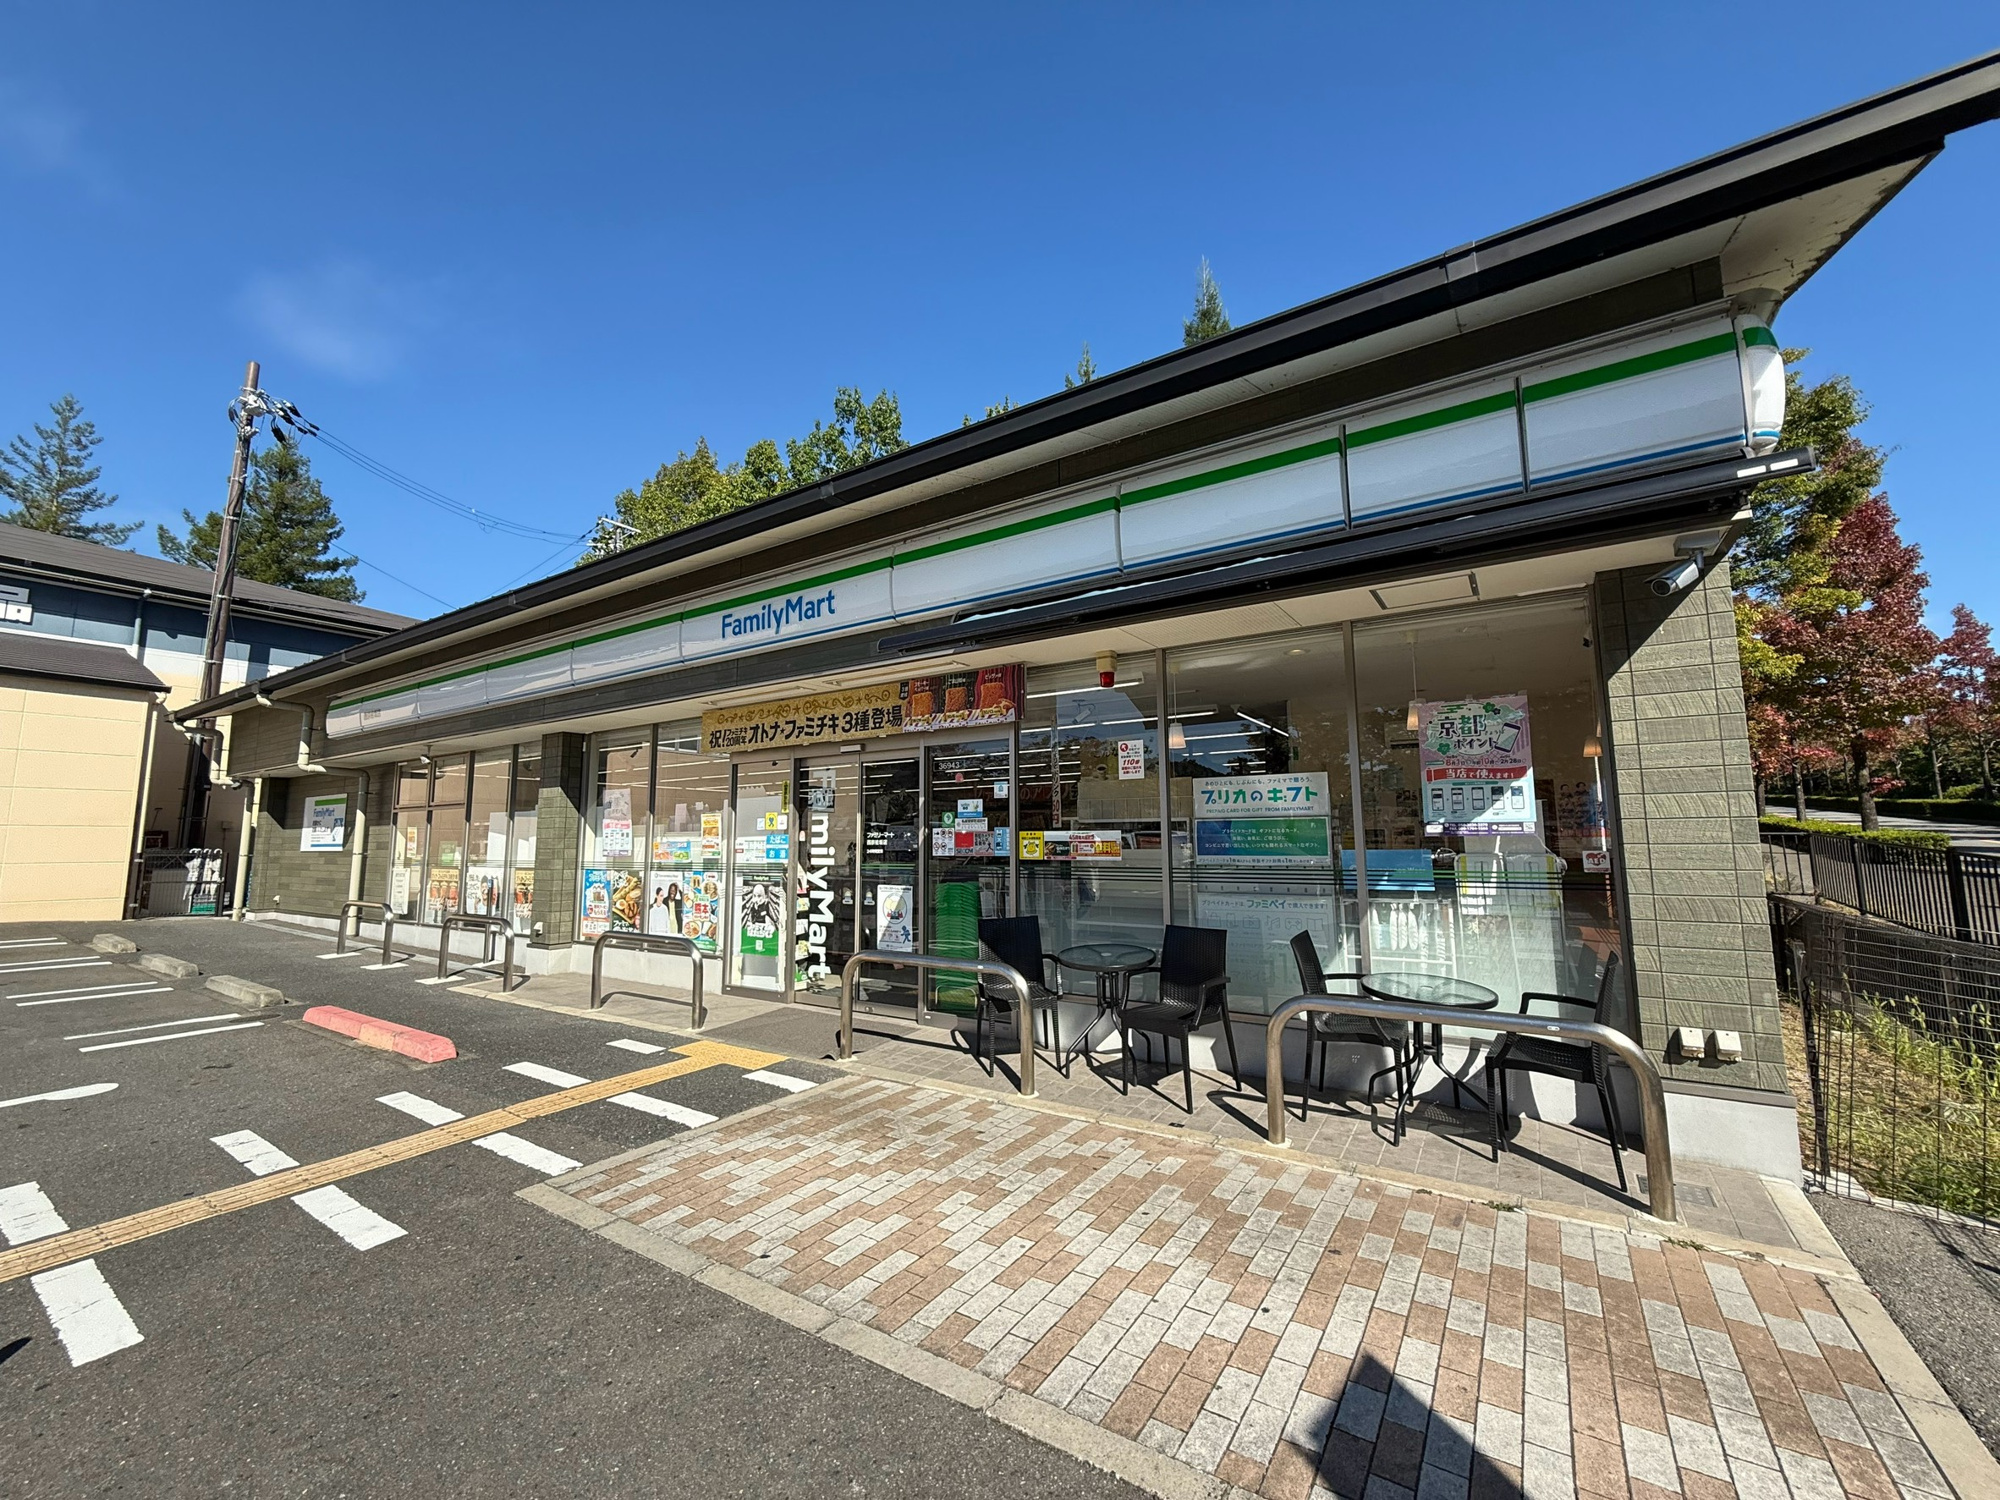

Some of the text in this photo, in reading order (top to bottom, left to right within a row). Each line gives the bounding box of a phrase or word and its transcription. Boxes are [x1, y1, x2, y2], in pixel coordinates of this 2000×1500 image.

[721, 589, 836, 638] FamilyMart
[1438, 714, 1487, 738] 京都
[726, 727, 748, 737] ファミチキ
[1453, 737, 1497, 749] ポイント
[938, 761, 960, 770] 36943
[313, 808, 335, 819] FamilyMart
[769, 835, 787, 844] たばこ
[807, 769, 836, 980] FmilyMart
